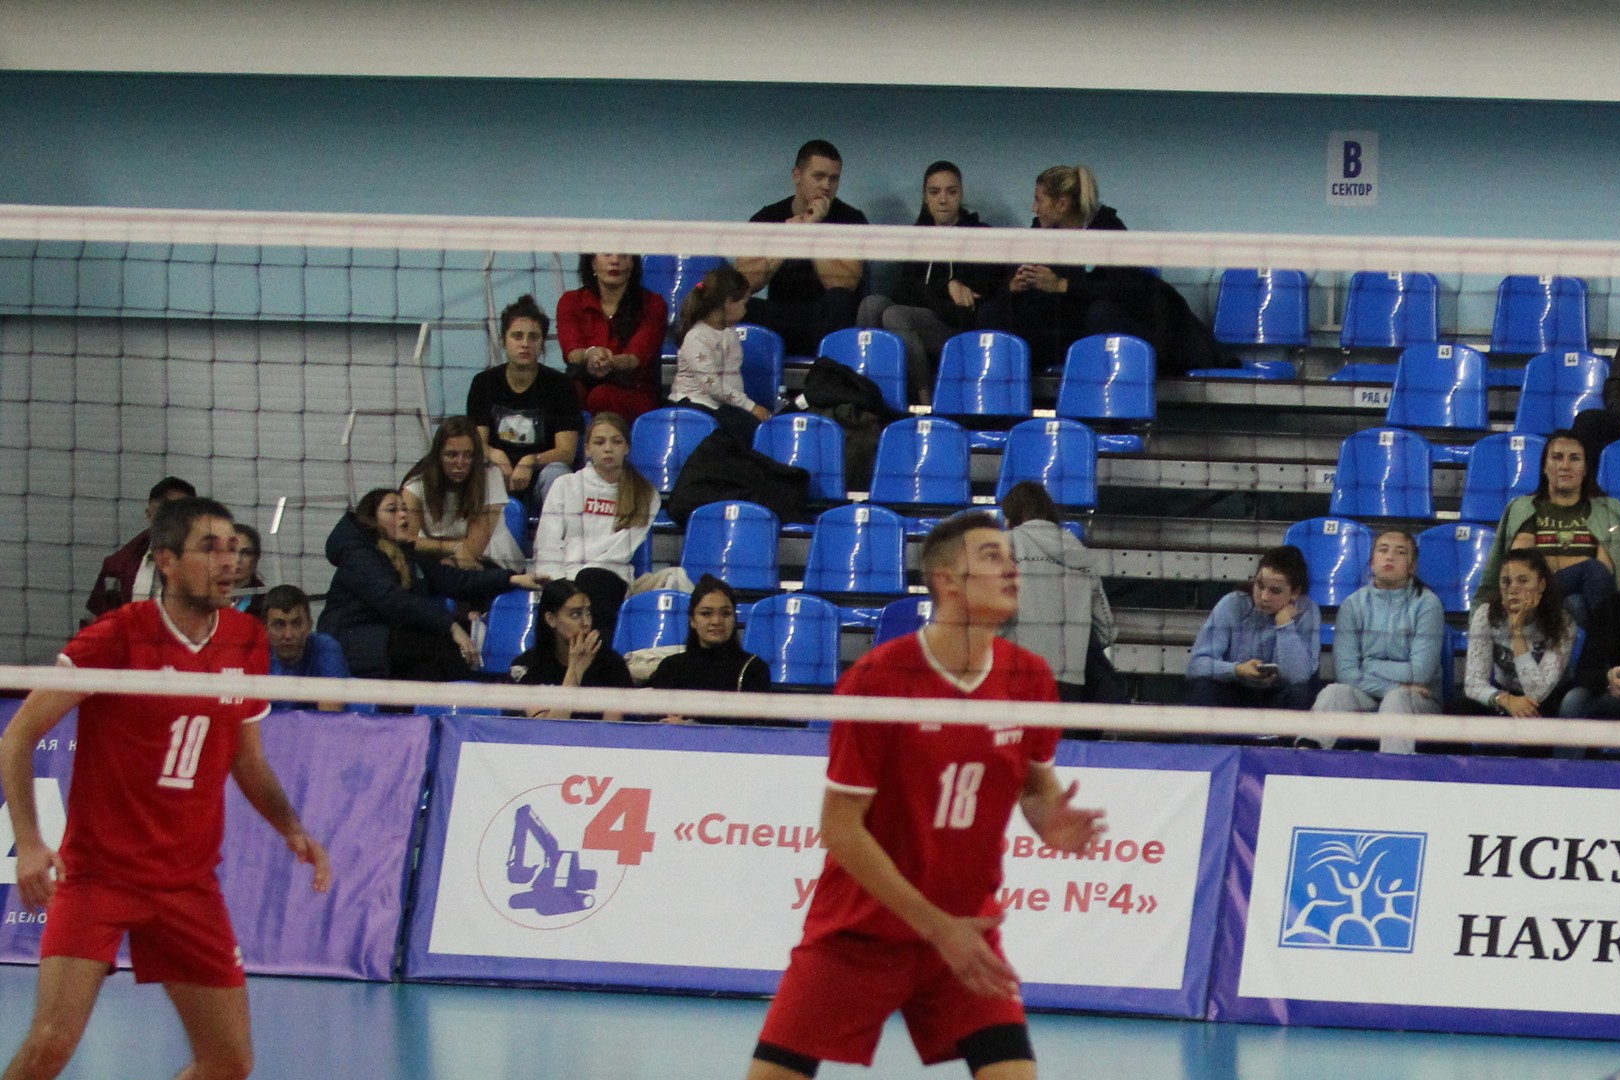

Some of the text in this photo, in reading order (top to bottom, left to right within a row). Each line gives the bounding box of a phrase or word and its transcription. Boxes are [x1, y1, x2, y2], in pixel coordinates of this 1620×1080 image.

[1343, 140, 1362, 178] В
[1331, 182, 1373, 196] СЕКТОР
[161, 715, 211, 779] 10
[933, 762, 985, 829] 18
